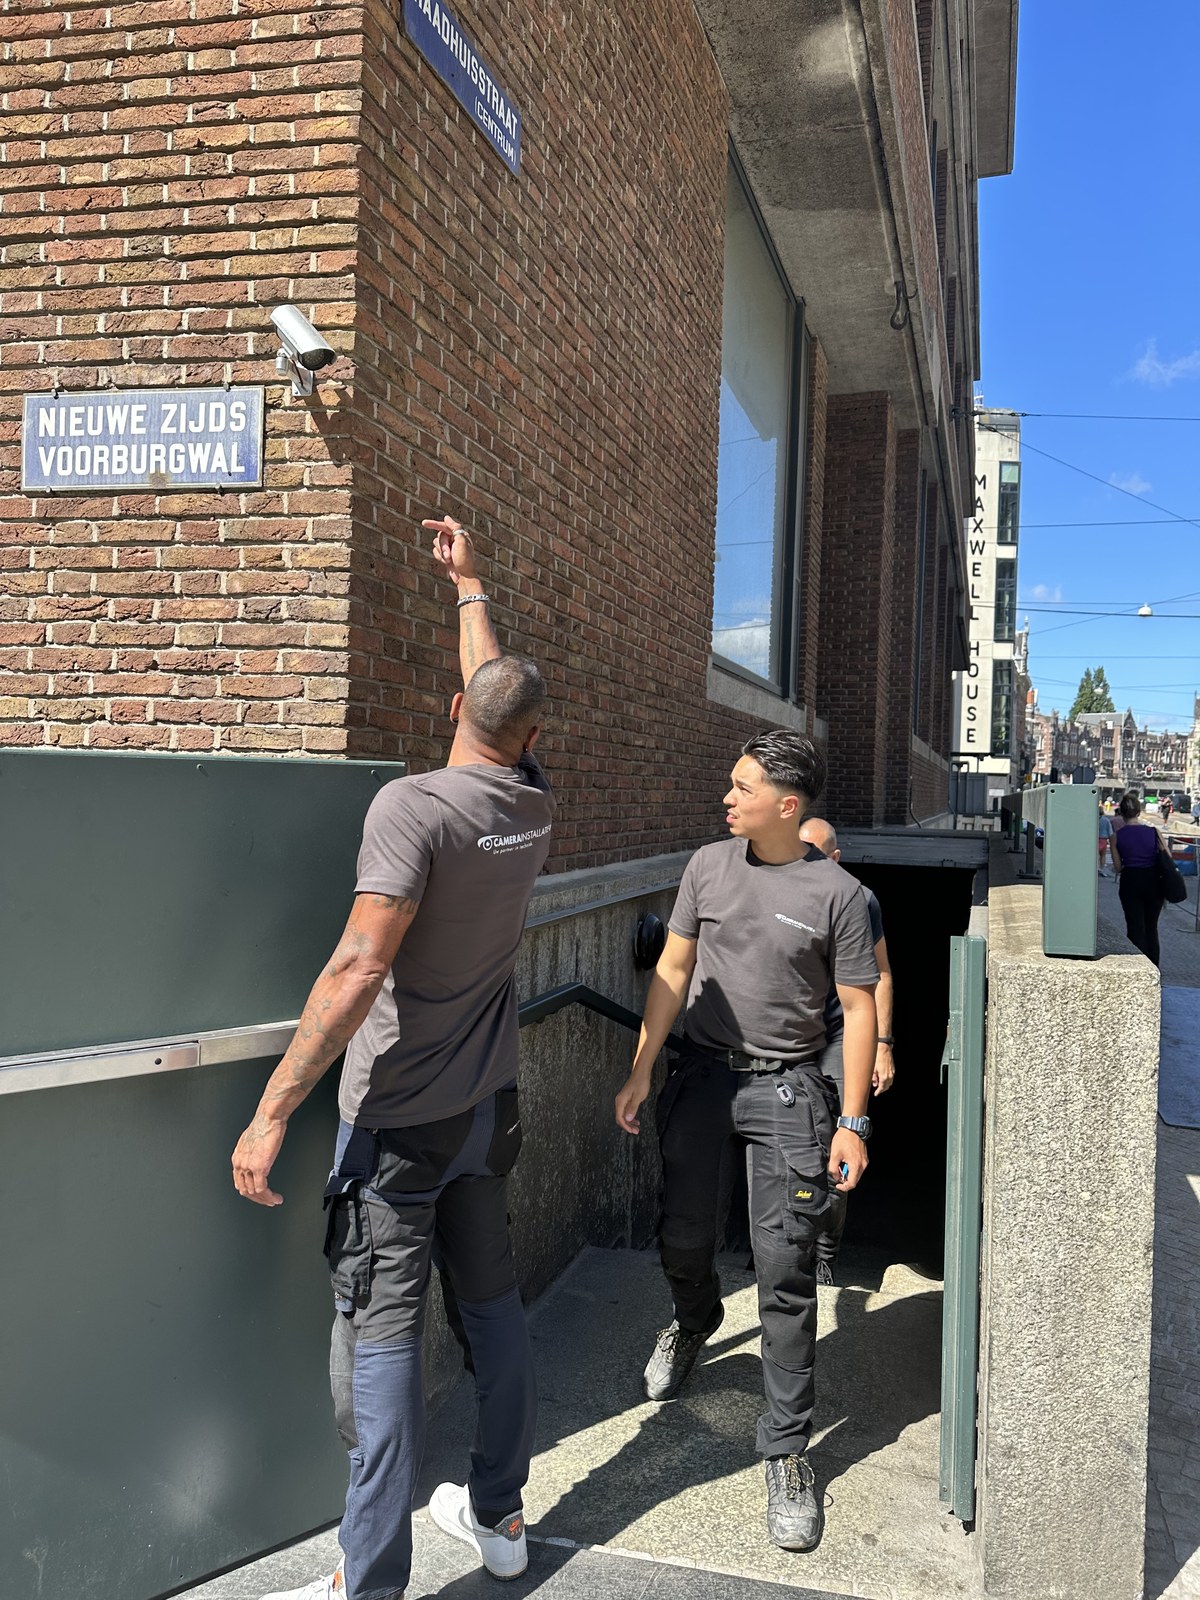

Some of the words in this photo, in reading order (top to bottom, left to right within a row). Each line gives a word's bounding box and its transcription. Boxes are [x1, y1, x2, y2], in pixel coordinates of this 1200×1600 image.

[414, 0, 518, 140] AADHUISSTRAAT
[474, 96, 517, 166] (CENTRUM)
[38, 404, 147, 437] NIEUWE
[160, 401, 246, 434] ZIJDS
[38, 442, 246, 477] VOORBURGWAL
[969, 474, 986, 621] MAXWELL
[966, 641, 979, 743] HOUSE
